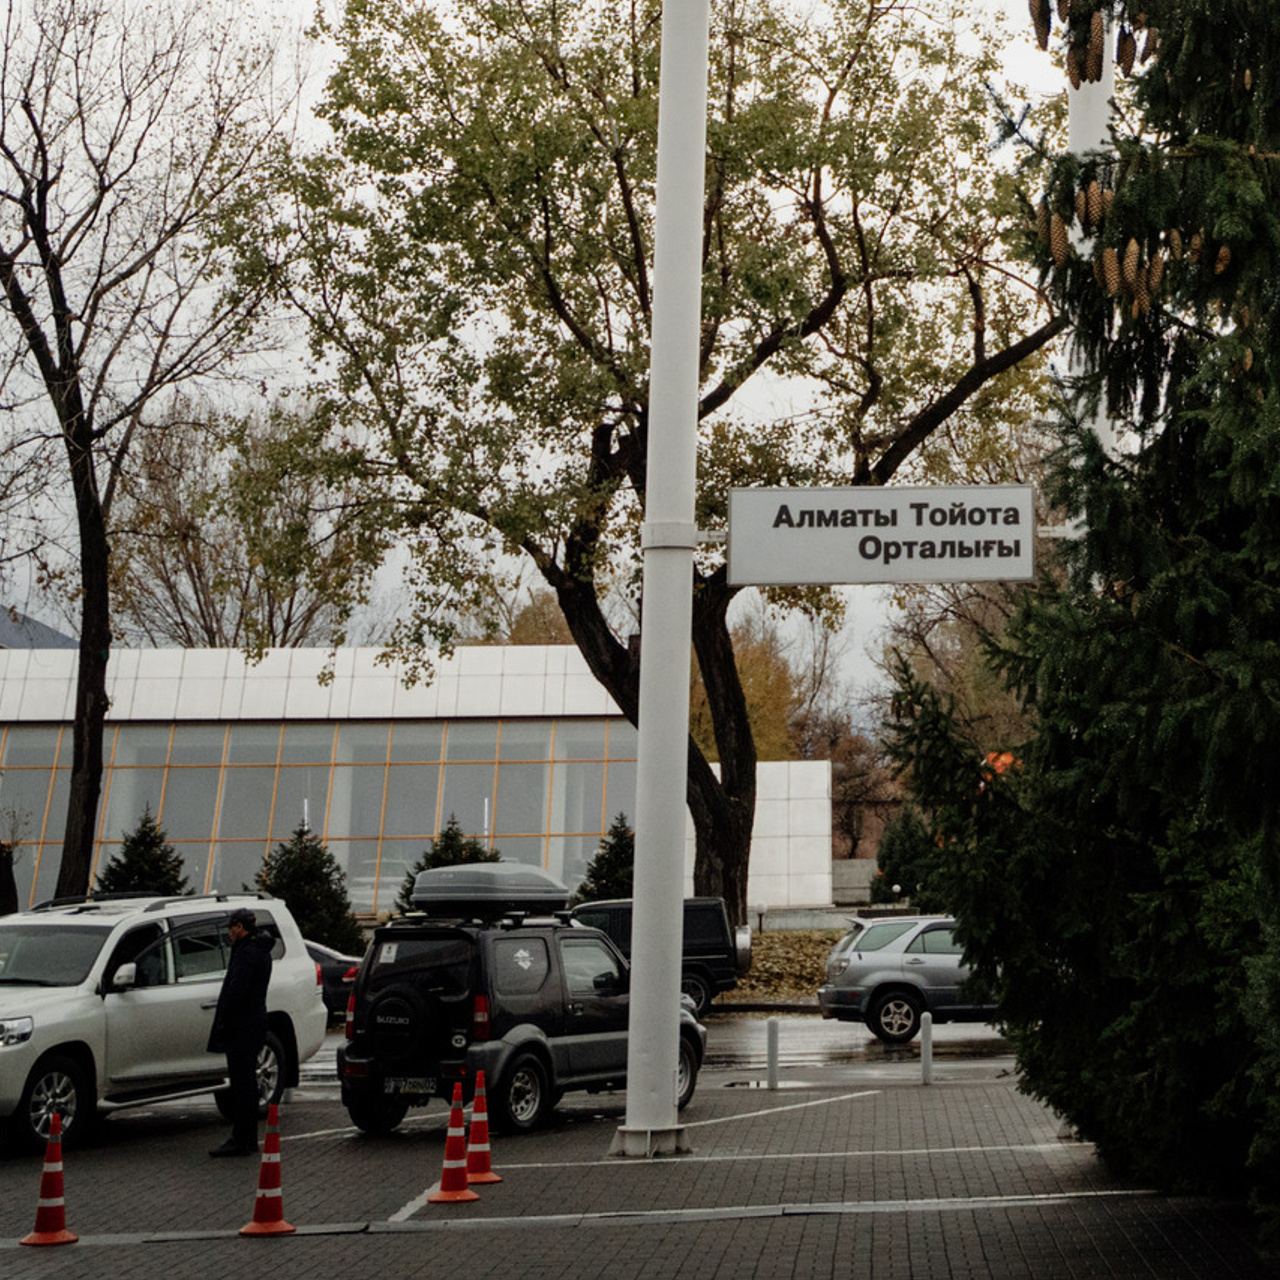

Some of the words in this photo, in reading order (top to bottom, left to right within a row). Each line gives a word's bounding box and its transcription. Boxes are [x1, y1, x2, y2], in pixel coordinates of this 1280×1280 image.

[772, 504, 898, 528] Алматы
[909, 502, 1020, 527] Тойота
[858, 535, 1021, 565] Орталығы
[376, 1015, 410, 1025] SUZUKI
